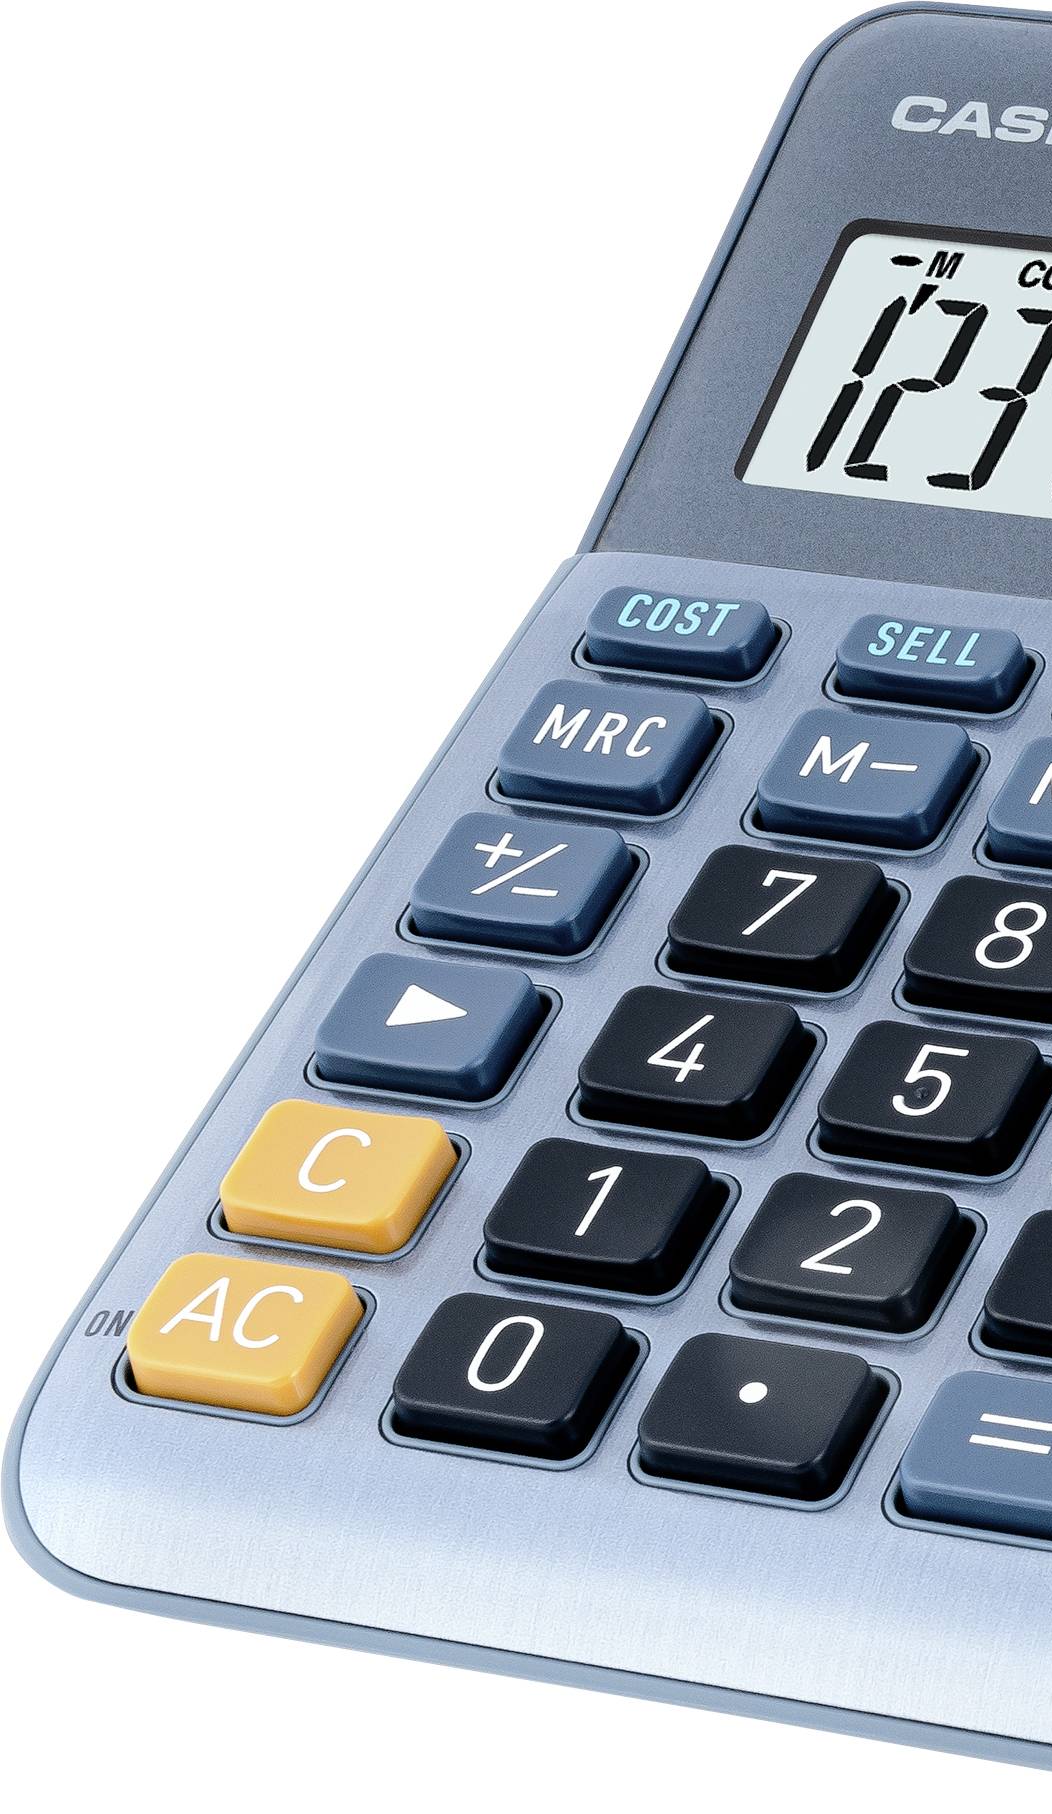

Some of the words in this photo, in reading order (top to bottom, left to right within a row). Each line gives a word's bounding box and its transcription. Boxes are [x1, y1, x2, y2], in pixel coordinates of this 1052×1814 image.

[618, 594, 740, 636] COST
[868, 622, 979, 666] SELL
[534, 704, 666, 756] MRC
[742, 870, 816, 935] 7
[976, 902, 1046, 968] 8
[648, 1015, 714, 1082] 4
[893, 1045, 969, 1115] 5
[299, 1129, 371, 1192] C
[575, 1167, 622, 1236] 1
[801, 1200, 881, 1274] 2
[84, 1309, 135, 1337] ON
[160, 1276, 303, 1349] AC
[468, 1316, 543, 1391] 0
